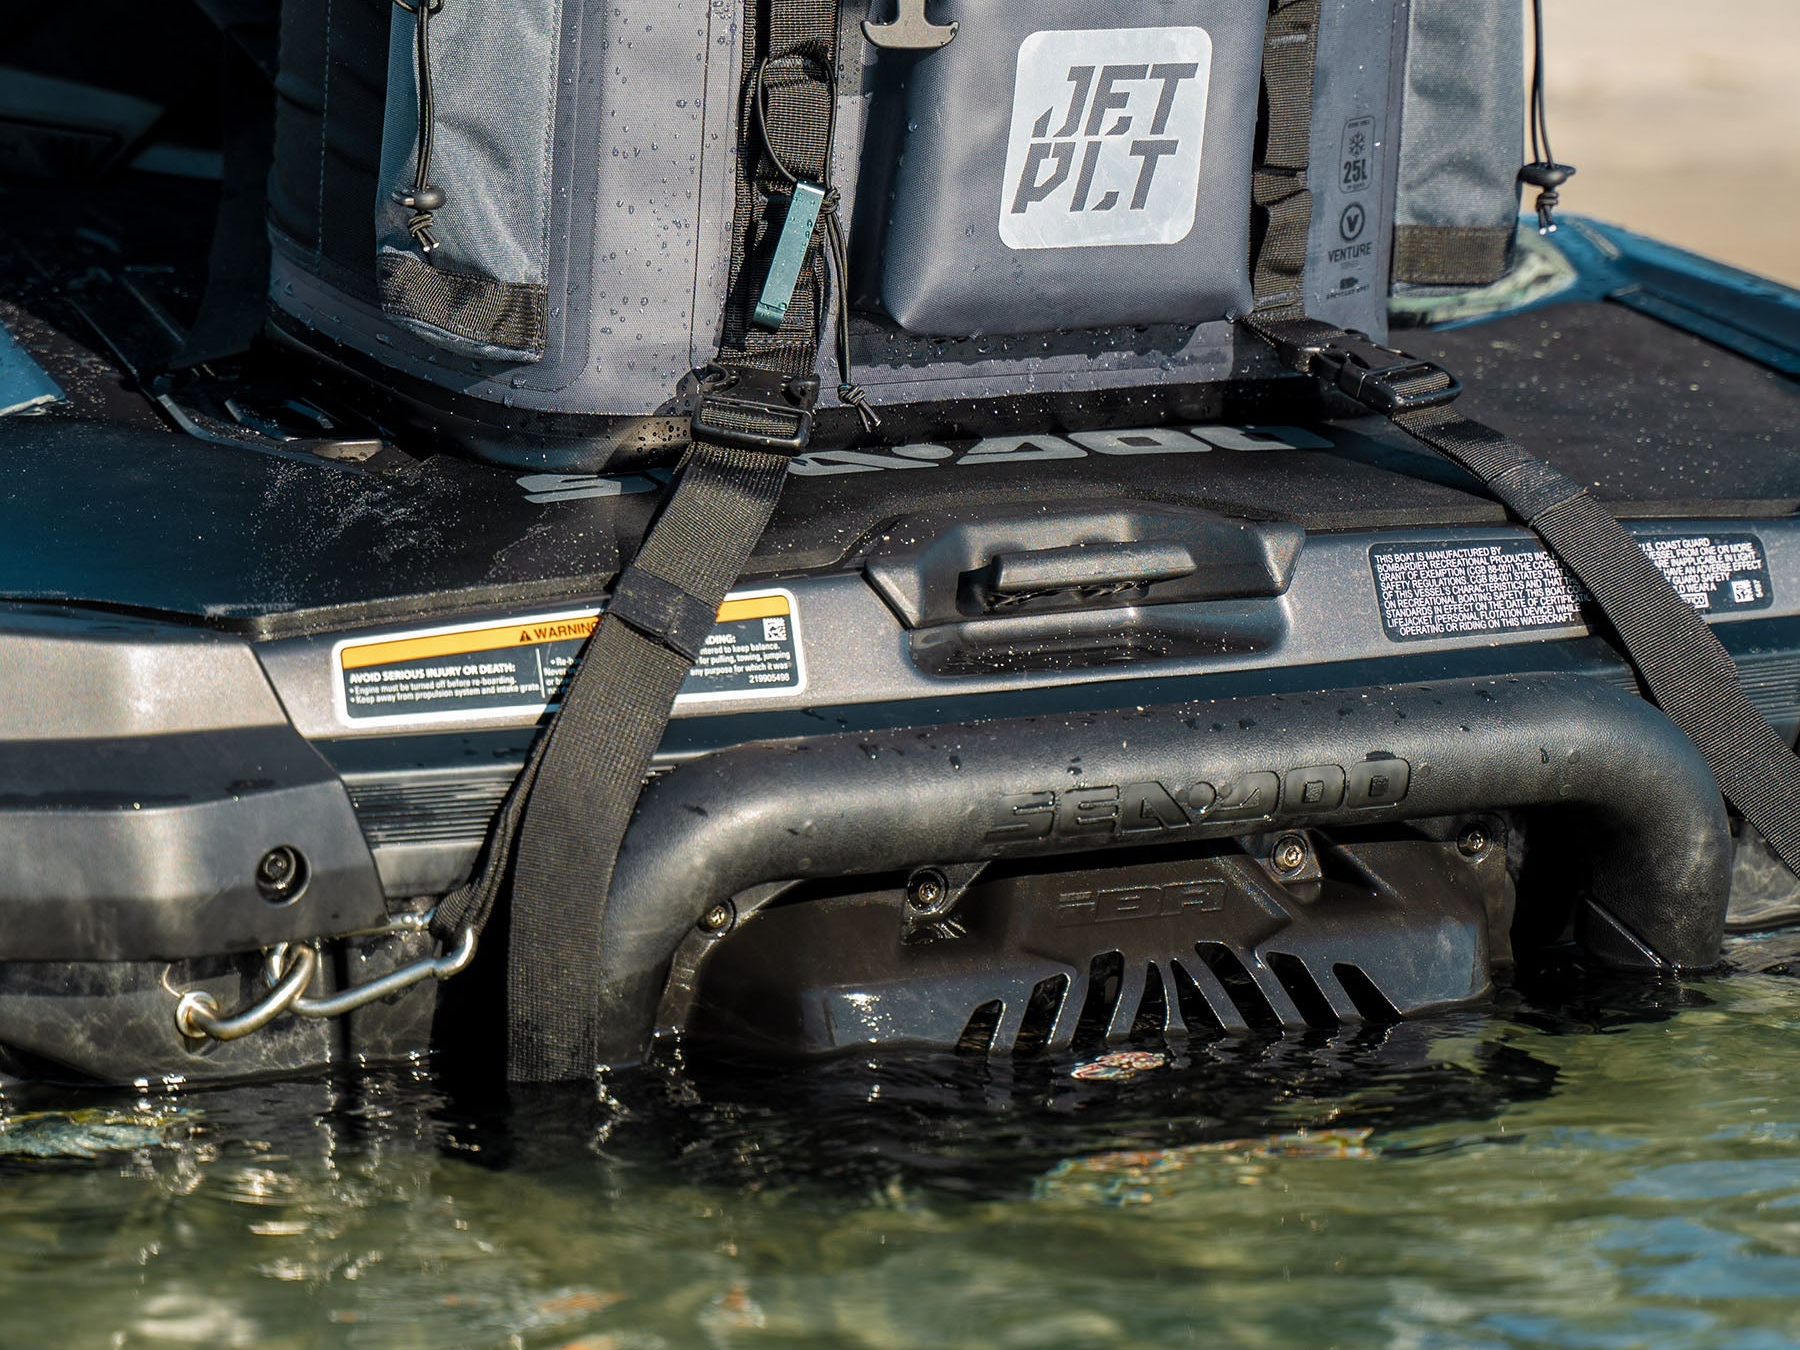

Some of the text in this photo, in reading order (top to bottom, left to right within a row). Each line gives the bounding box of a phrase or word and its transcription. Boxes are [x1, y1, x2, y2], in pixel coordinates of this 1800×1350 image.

[1031, 62, 1199, 138] JET
[1343, 159, 1368, 185] 25L
[1328, 241, 1373, 263] VENTURE
[1374, 546, 1502, 563] THIS BOAT IS MANUFACTURED BY
[1376, 560, 1428, 572] BOMBARDIER
[1429, 556, 1489, 568] RECREATIONAL
[1489, 552, 1533, 564] PRODUCTS
[1654, 539, 1681, 550] COAST
[1681, 537, 1711, 548] GUARD
[1378, 571, 1406, 582] GRANT
[1406, 570, 1419, 579] OF
[1419, 566, 1465, 578] EXEMPTION
[1466, 564, 1486, 576] (CGB
[1515, 561, 1532, 571] THE
[1532, 559, 1559, 569] COAST
[1716, 544, 1730, 554] OR
[1380, 580, 1411, 590] SAFETY
[1469, 573, 1487, 583] CGB
[1513, 569, 1543, 580] STATES
[1543, 567, 1563, 577] THAT
[1381, 590, 1393, 599] OF
[1395, 588, 1413, 598] THIS
[1413, 585, 1451, 597] VESSEL'S
[1451, 580, 1524, 594] CHARACTERISTICS
[1525, 578, 1542, 588] AND
[1542, 577, 1563, 587] THAT
[1383, 599, 1396, 609] ON
[1397, 594, 1457, 607] RECREATIONAL
[1457, 591, 1492, 602] BOATING
[1525, 587, 1544, 597] THIS
[1544, 586, 1566, 595] BOAT
[1671, 574, 1700, 585] GUARD
[1700, 572, 1731, 582] SAFETY
[1385, 606, 1433, 618] STANDARDS
[1433, 605, 1443, 614] IN
[1443, 602, 1474, 613] EFFECT
[1474, 601, 1488, 611] ON
[1488, 600, 1505, 609] THE
[1505, 598, 1526, 608] DATE
[1526, 597, 1539, 606] OF
[1685, 582, 1710, 592] WEAR
[1709, 582, 1717, 591] A
[1387, 615, 1433, 627] LIFEJACKET
[1434, 611, 1479, 624] (PERSONAL
[1479, 607, 1522, 619] FLOTATION
[1523, 604, 1555, 616] DEVICE)
[1555, 602, 1581, 613] WHILE
[1398, 623, 1445, 635] OPERATING
[1444, 621, 1458, 632] OR
[1459, 619, 1487, 630] RIDING
[1487, 618, 1500, 628] ON
[1500, 616, 1520, 627] THIS
[723, 645, 731, 653] to
[731, 643, 749, 654] keep
[348, 661, 516, 684] AVOID SERIOUS INJURY OR DEATH:
[733, 664, 744, 672] for
[354, 684, 380, 696] Engine
[379, 683, 398, 693] must
[398, 682, 409, 691] be
[409, 680, 434, 690] turned
[446, 677, 470, 688] before
[355, 694, 375, 705] Keep
[375, 694, 395, 703] away
[396, 691, 414, 700] from
[414, 688, 453, 700] propulsion
[453, 687, 480, 697] system
[480, 685, 495, 694] and
